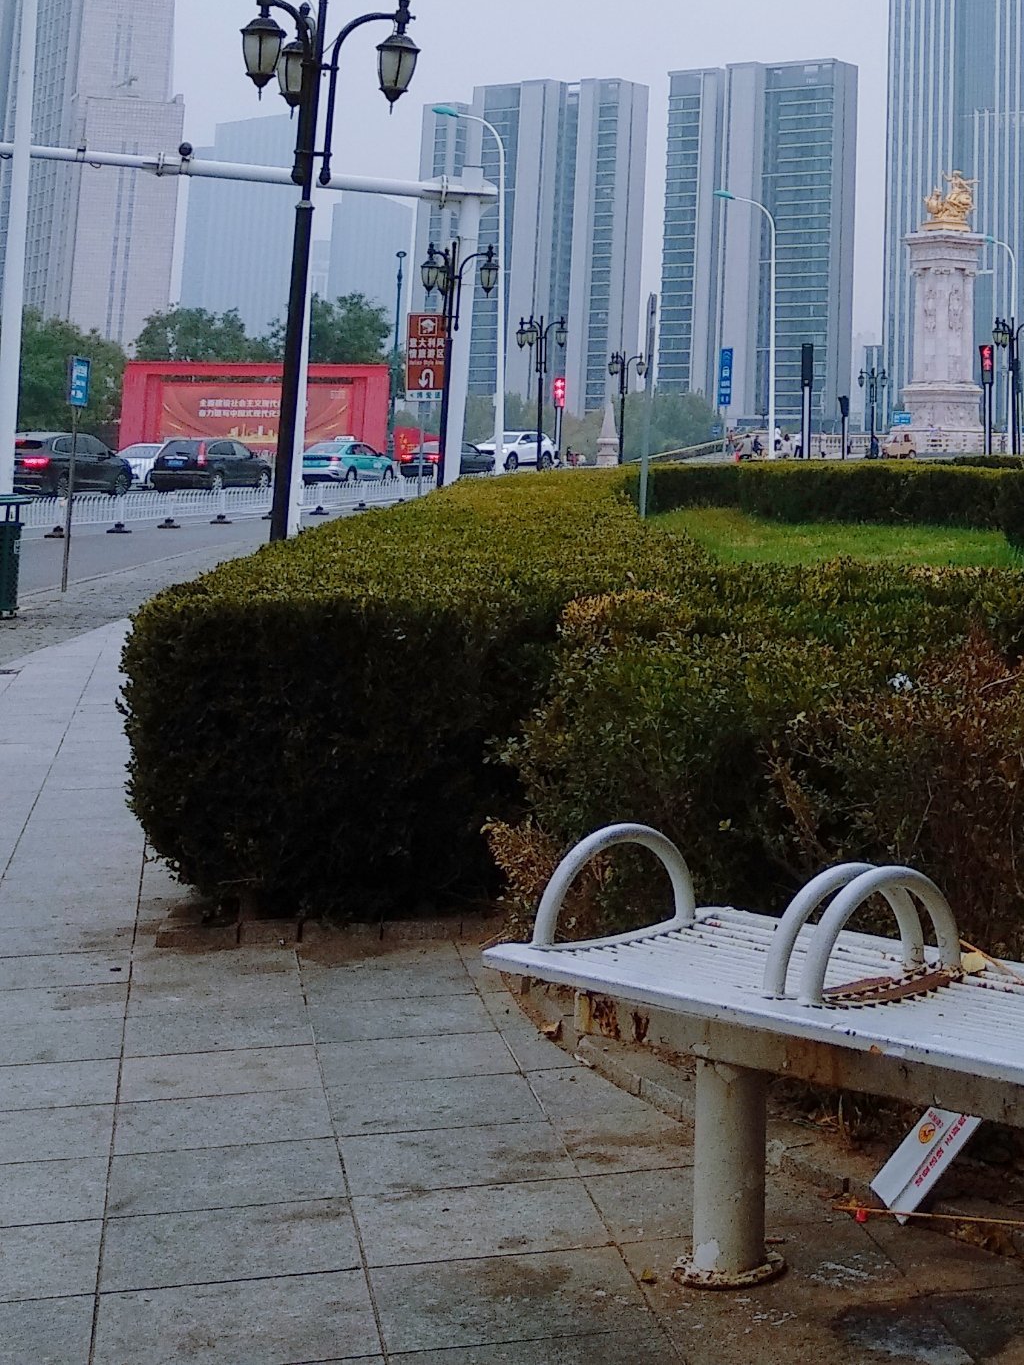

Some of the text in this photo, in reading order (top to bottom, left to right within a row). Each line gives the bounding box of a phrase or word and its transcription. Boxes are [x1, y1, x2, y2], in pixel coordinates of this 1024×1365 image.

[410, 338, 445, 347] 意大利风
[409, 349, 445, 358] 情旅游区
